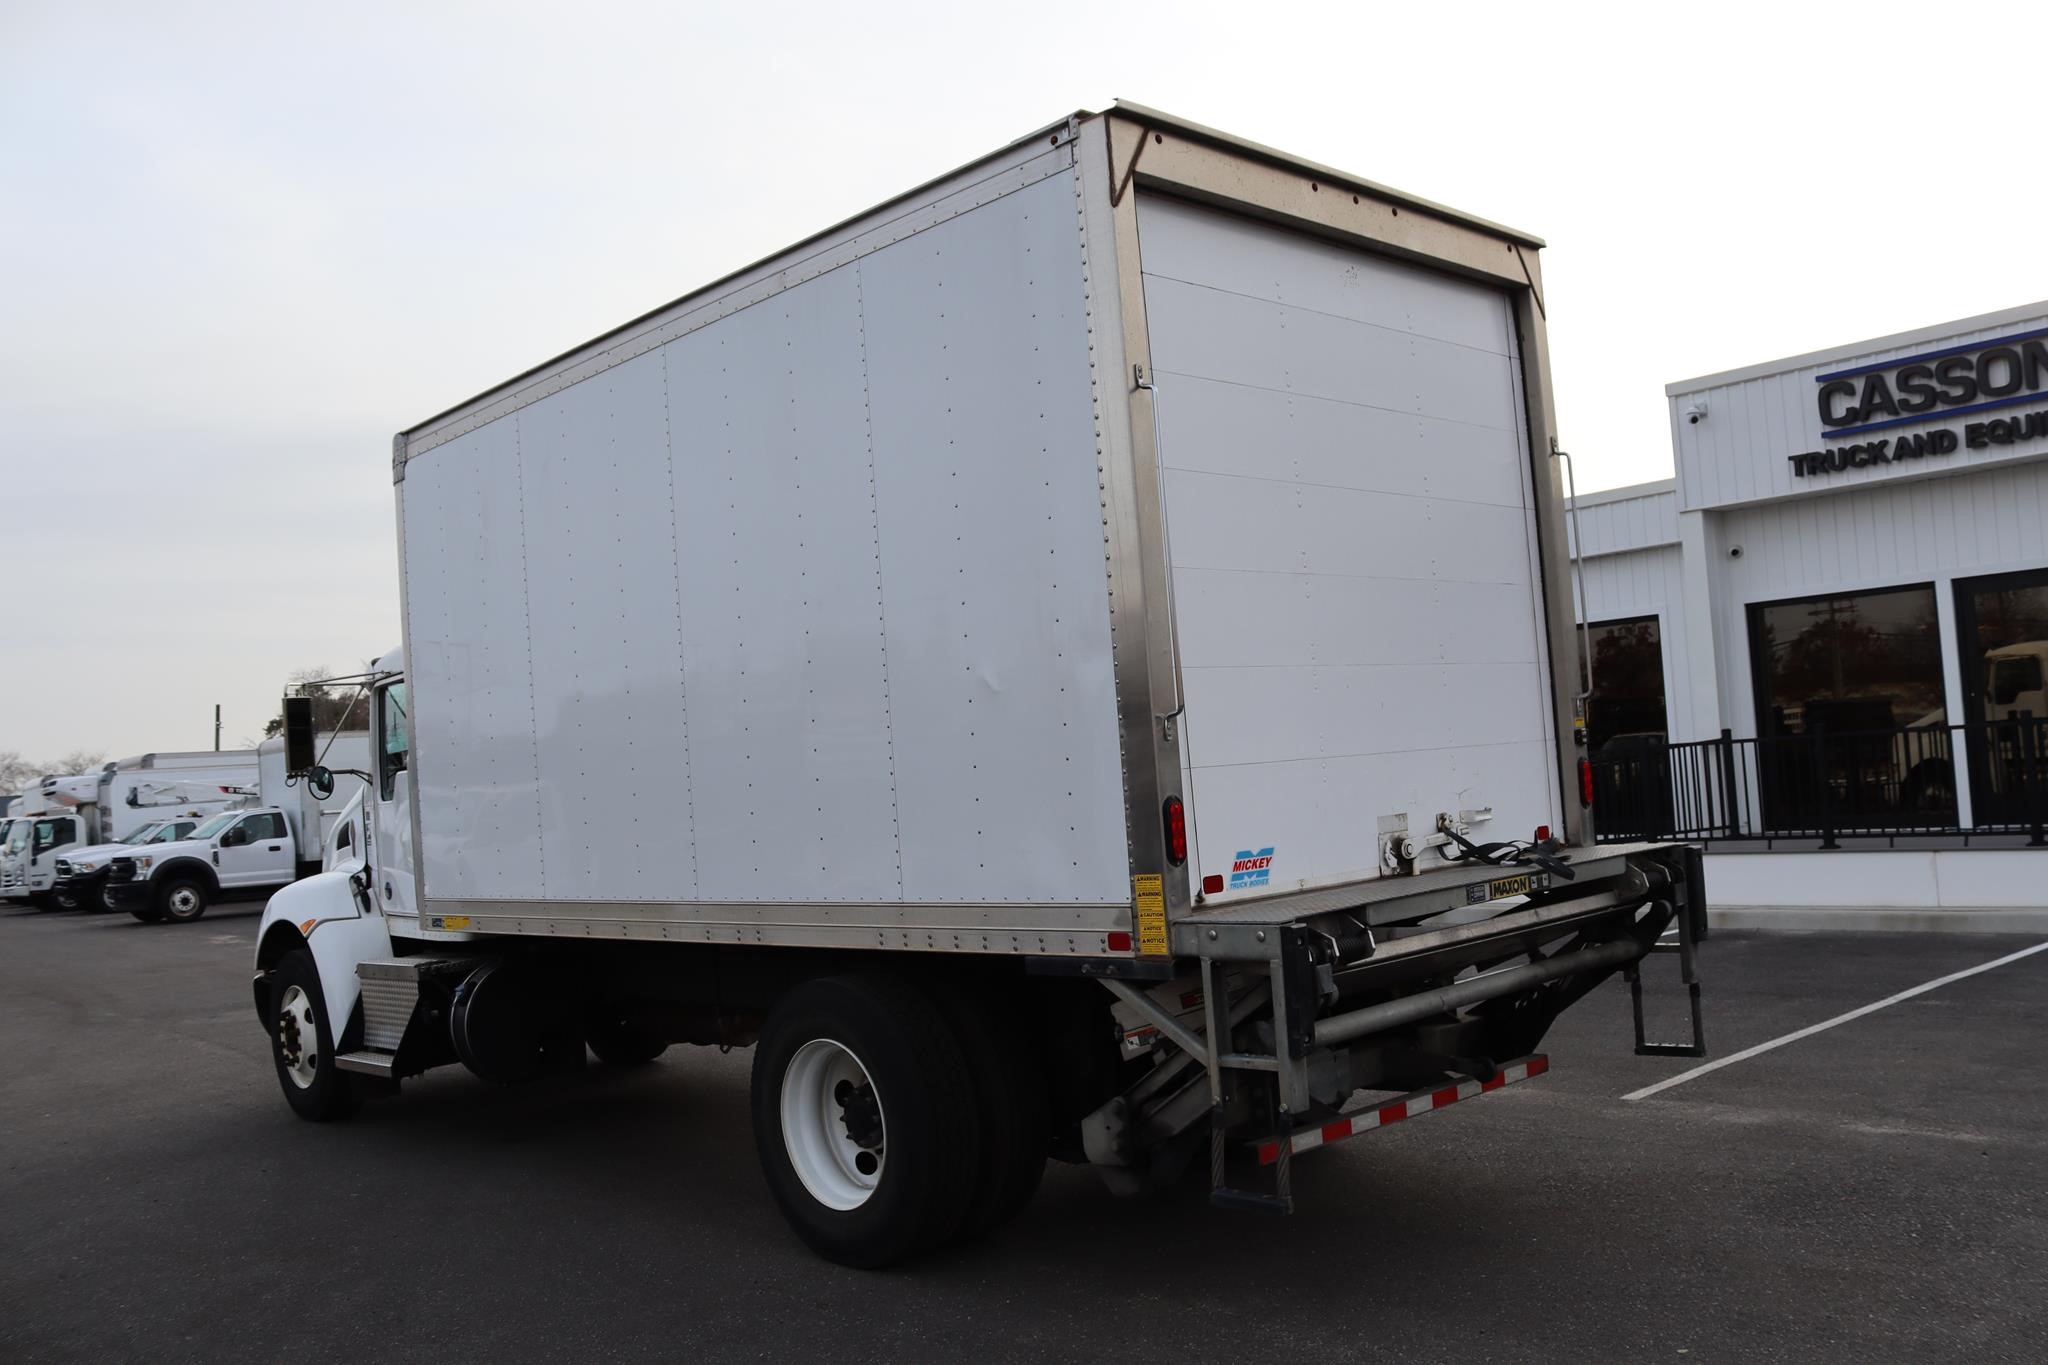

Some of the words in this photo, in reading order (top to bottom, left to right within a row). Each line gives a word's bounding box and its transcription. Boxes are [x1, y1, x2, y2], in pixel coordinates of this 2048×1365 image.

[1788, 439, 1892, 478] TRUCK
[1892, 428, 1959, 462] AND
[1965, 410, 2048, 450] EQUI
[1233, 856, 1272, 872] MICKEY
[1493, 877, 1527, 897] MAXON
